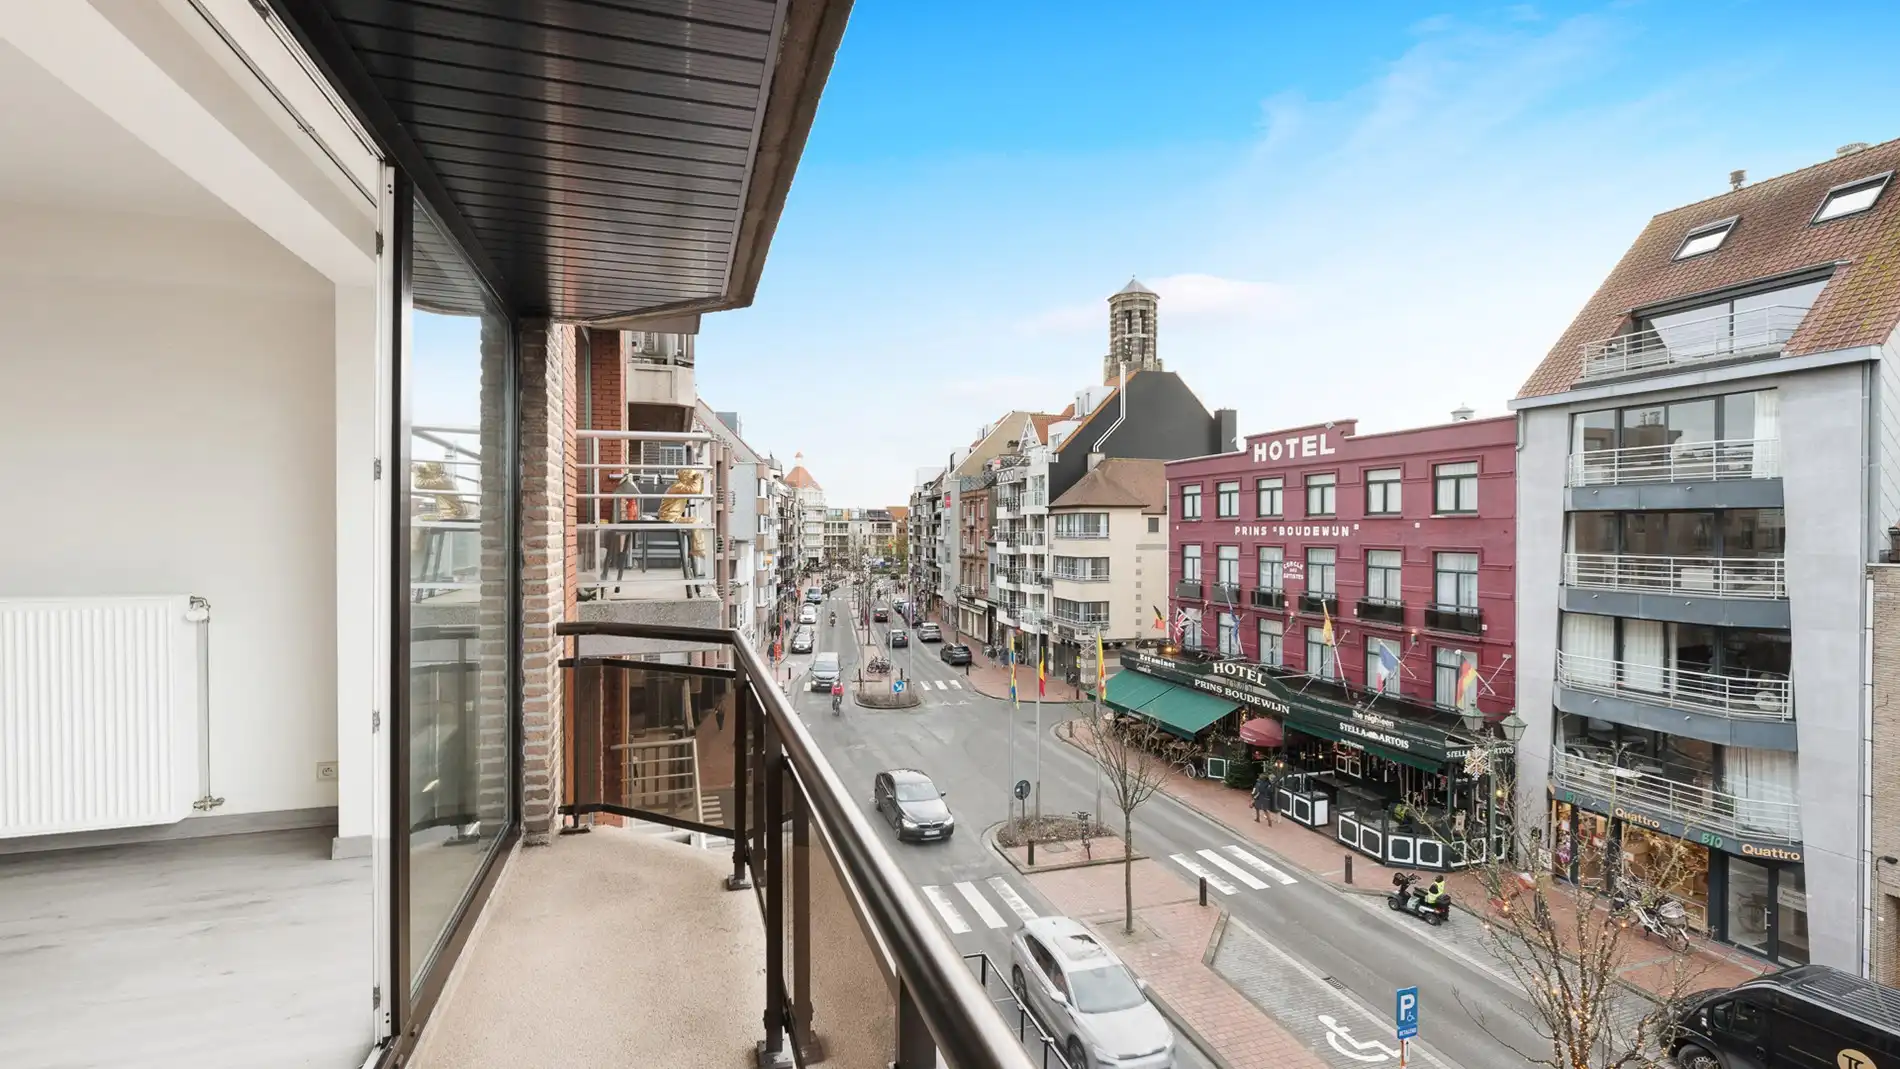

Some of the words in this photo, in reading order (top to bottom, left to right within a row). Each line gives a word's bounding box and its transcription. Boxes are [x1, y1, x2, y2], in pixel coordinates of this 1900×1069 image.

[1253, 433, 1336, 463] HOTEL
[1234, 525, 1268, 536] PRINS
[1212, 662, 1267, 687] HOTEL
[1194, 679, 1223, 694] PRINS
[1225, 687, 1290, 714] BOUDEWIJN
[1340, 722, 1367, 738] STELLA
[1378, 733, 1410, 749] ARTOIS
[1446, 749, 1470, 759] STELL
[1492, 746, 1514, 754] RTOIS
[1614, 807, 1660, 828] Quattro
[1700, 831, 1724, 849] BIO
[1741, 843, 1801, 861] Quattro
[1400, 993, 1416, 1021] P
